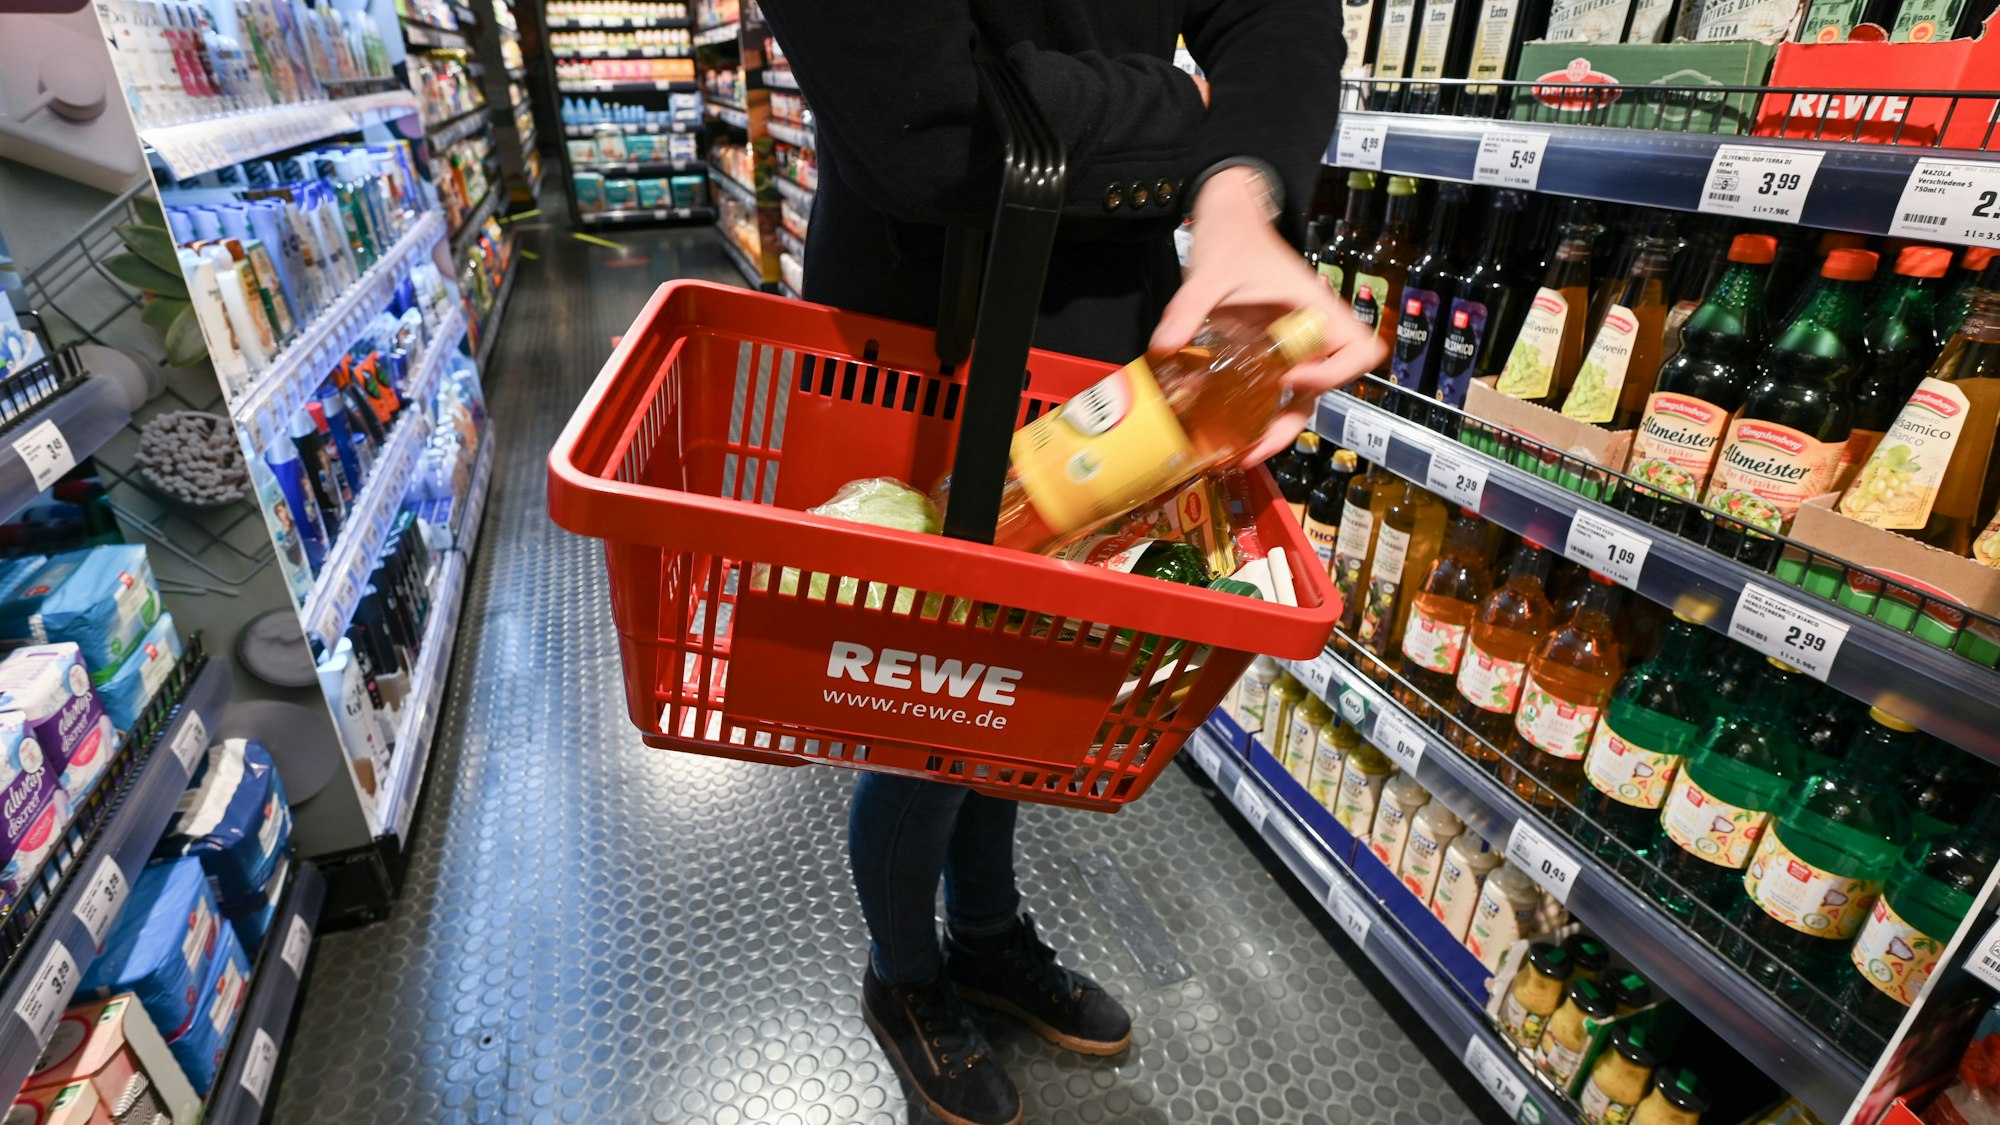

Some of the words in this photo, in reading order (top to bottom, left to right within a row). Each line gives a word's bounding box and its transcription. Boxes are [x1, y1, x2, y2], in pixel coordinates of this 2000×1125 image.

[1391, 12, 1405, 23] Extra
[1431, 9, 1446, 22] Extra
[1490, 5, 1508, 19] Extra
[1708, 24, 1738, 38] EXTRA
[1790, 93, 1908, 122] REWE
[1361, 138, 1378, 152] 4.99
[1510, 151, 1536, 169] 5.49
[1721, 154, 1751, 162] OLIVENOEL
[1758, 172, 1801, 196] 3.99
[1918, 178, 1966, 188] Verschiedene
[1921, 169, 1952, 178] MAZOLA
[1914, 185, 1937, 194] 750ml
[1937, 187, 1947, 195] FL
[1768, 207, 1790, 216] 7.98€
[1642, 415, 1719, 449] Altmeister
[1739, 425, 1802, 450] Hengstenberg
[1657, 444, 1693, 459] Klassiker
[1722, 443, 1812, 480] Altmeister
[1456, 475, 1478, 492] 2.39
[1739, 473, 1782, 492] Klassiker
[1309, 528, 1338, 543] THO
[1608, 544, 1636, 565] 1.09
[1744, 599, 1786, 621] HENGSTENBERG
[1764, 600, 1797, 617] BALSAMICO
[1797, 615, 1820, 628] BIANCO
[1784, 626, 1826, 651] 2.99
[827, 640, 1023, 706] REWE
[58, 690, 94, 737] always
[823, 688, 1007, 730] www.rewe.de
[61, 713, 89, 753] discreet
[4, 766, 46, 820] always
[8, 790, 41, 839] discreet
[1541, 859, 1567, 883] 0.45
[104, 873, 120, 902] 3.29
[51, 960, 70, 995] 3.29
